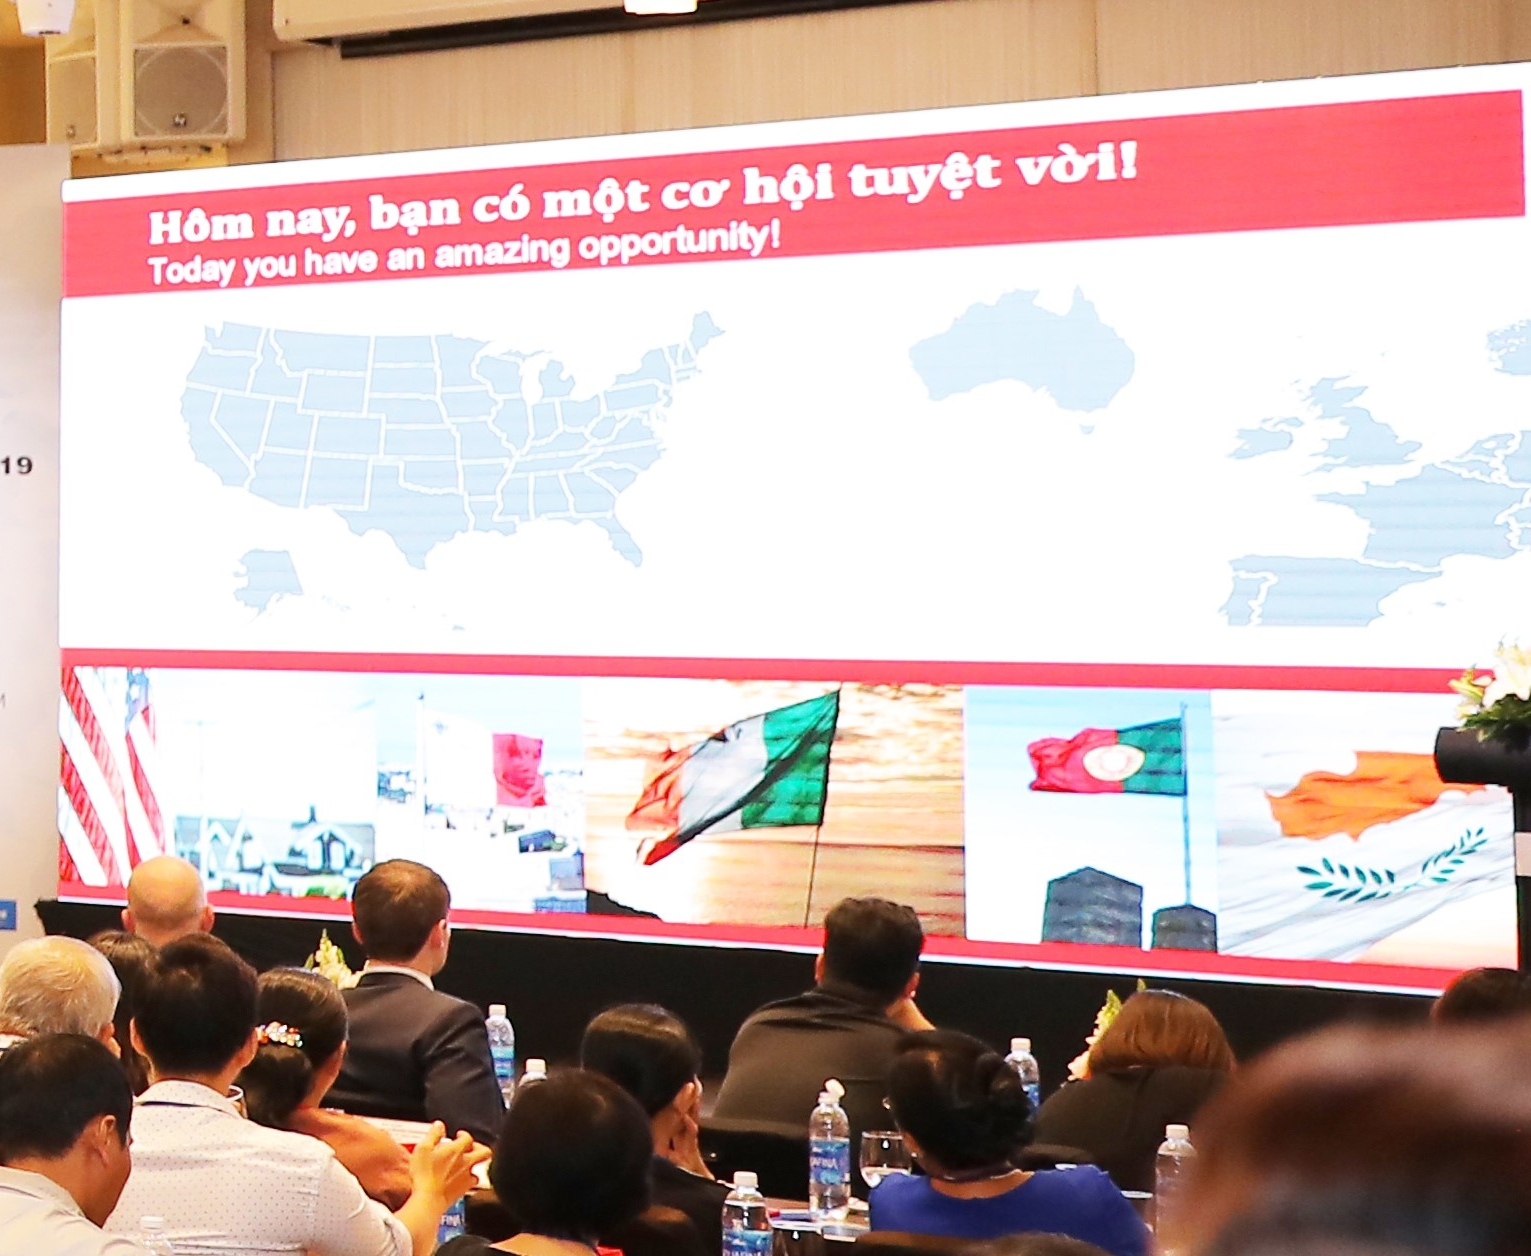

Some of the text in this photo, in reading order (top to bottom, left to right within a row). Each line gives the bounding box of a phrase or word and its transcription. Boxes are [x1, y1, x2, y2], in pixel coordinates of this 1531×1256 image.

[148, 140, 1139, 245] Hôm nay, bạn có một cơ hội tuyệt vời!
[148, 218, 782, 288] Today you have an amazing opportunity!
